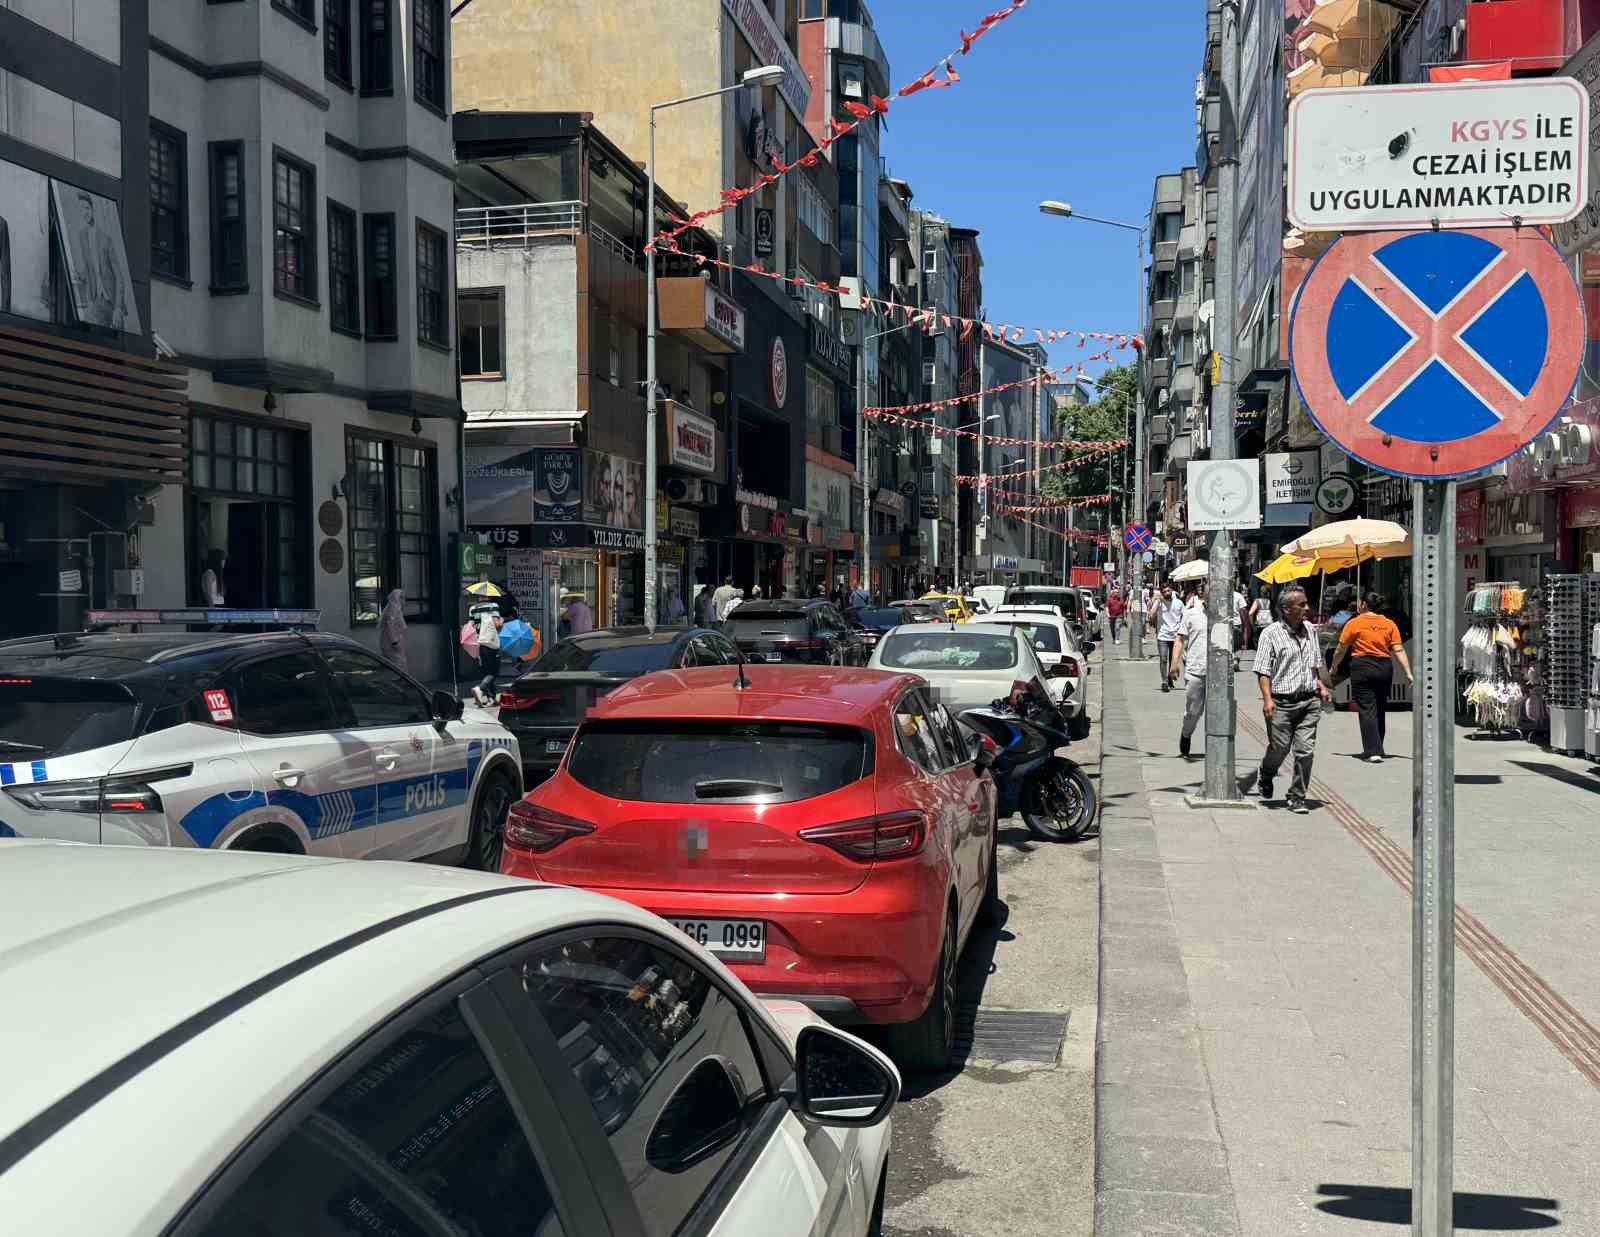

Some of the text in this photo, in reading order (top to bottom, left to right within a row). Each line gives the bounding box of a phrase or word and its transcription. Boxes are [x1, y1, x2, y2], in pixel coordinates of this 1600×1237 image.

[1451, 114, 1573, 143] KGYS İLE
[1495, 148, 1572, 179] İŞLEM
[1309, 182, 1572, 212] UYGULANMAKTADIR
[208, 693, 228, 709] 112
[405, 774, 446, 812] POLİS
[722, 923, 761, 948] 099
